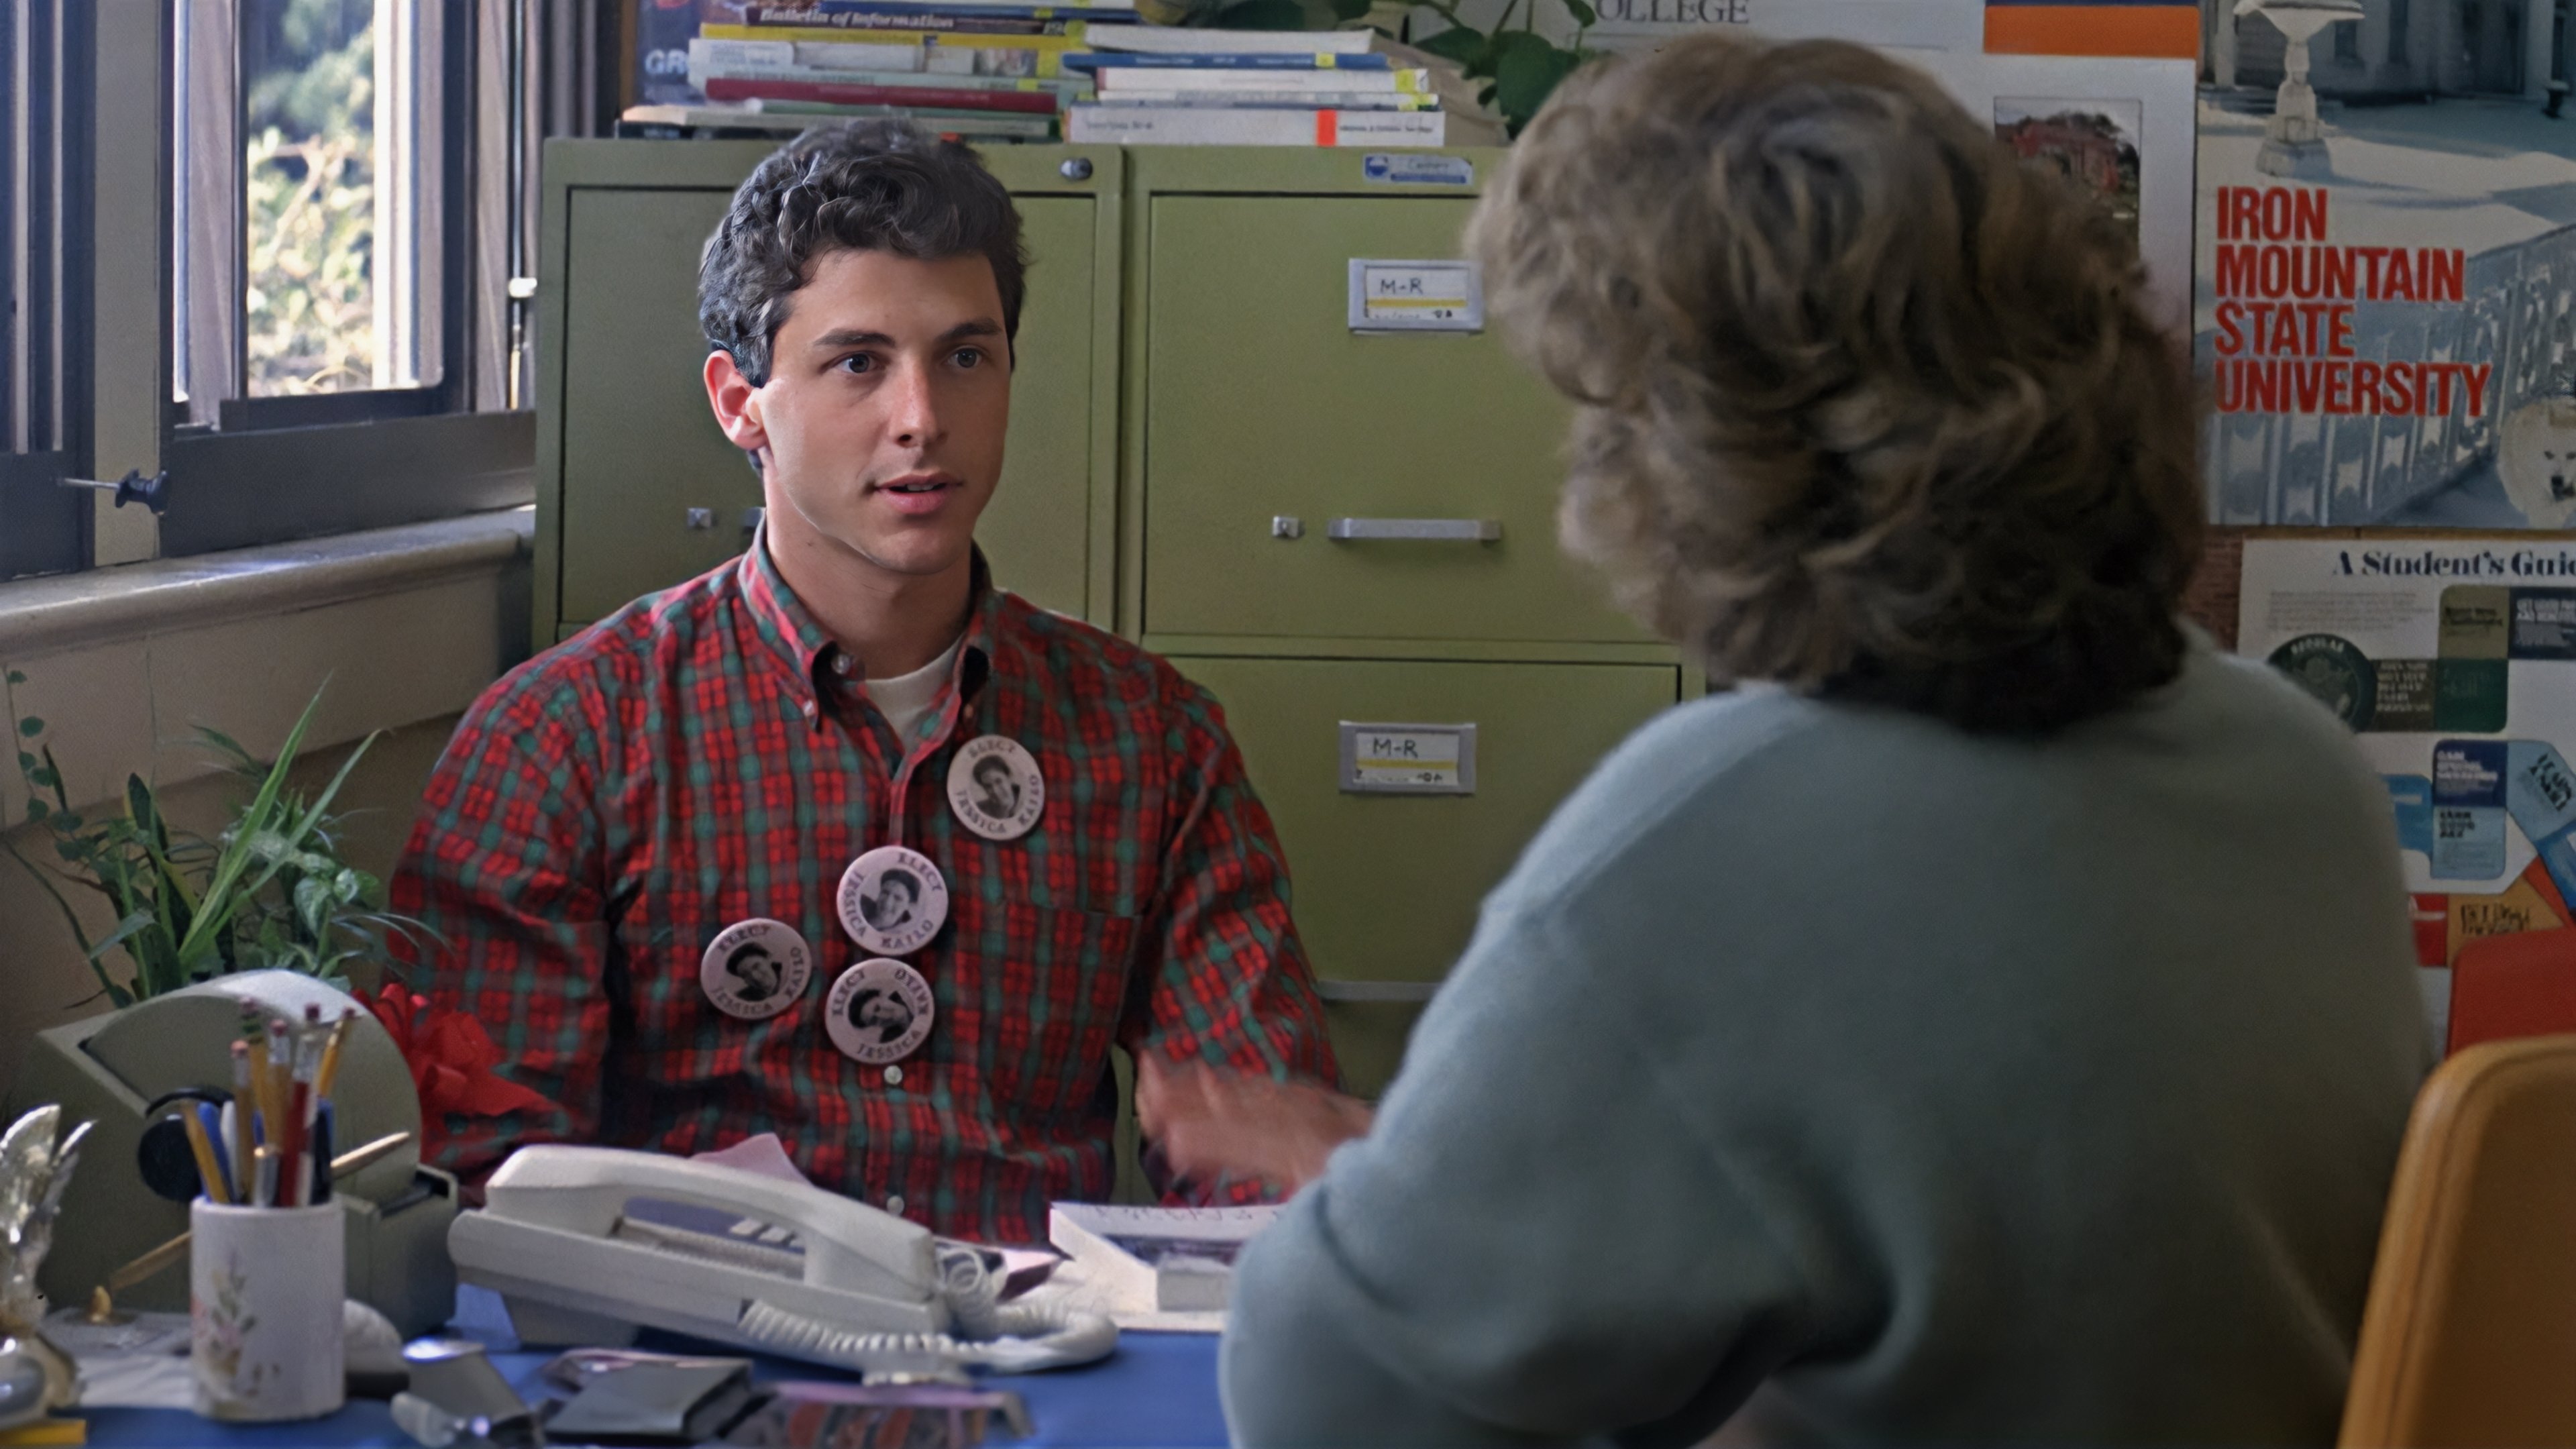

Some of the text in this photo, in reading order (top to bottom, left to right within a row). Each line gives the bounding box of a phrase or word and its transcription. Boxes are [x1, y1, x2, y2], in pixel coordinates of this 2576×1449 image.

[759, 7, 829, 23] Bulletin
[830, 11, 852, 27] of
[850, 11, 954, 28] Information
[1594, 0, 1749, 23] OLLEGE
[2217, 186, 2328, 241] IRON
[2216, 244, 2465, 302] MOUNTAIN
[2214, 302, 2355, 357] STATE
[2214, 360, 2493, 417] UNIVERSITY
[2332, 550, 2353, 576] A
[2361, 550, 2505, 577] Student's
[897, 852, 943, 892] ELECT
[843, 870, 868, 938] JESSICA
